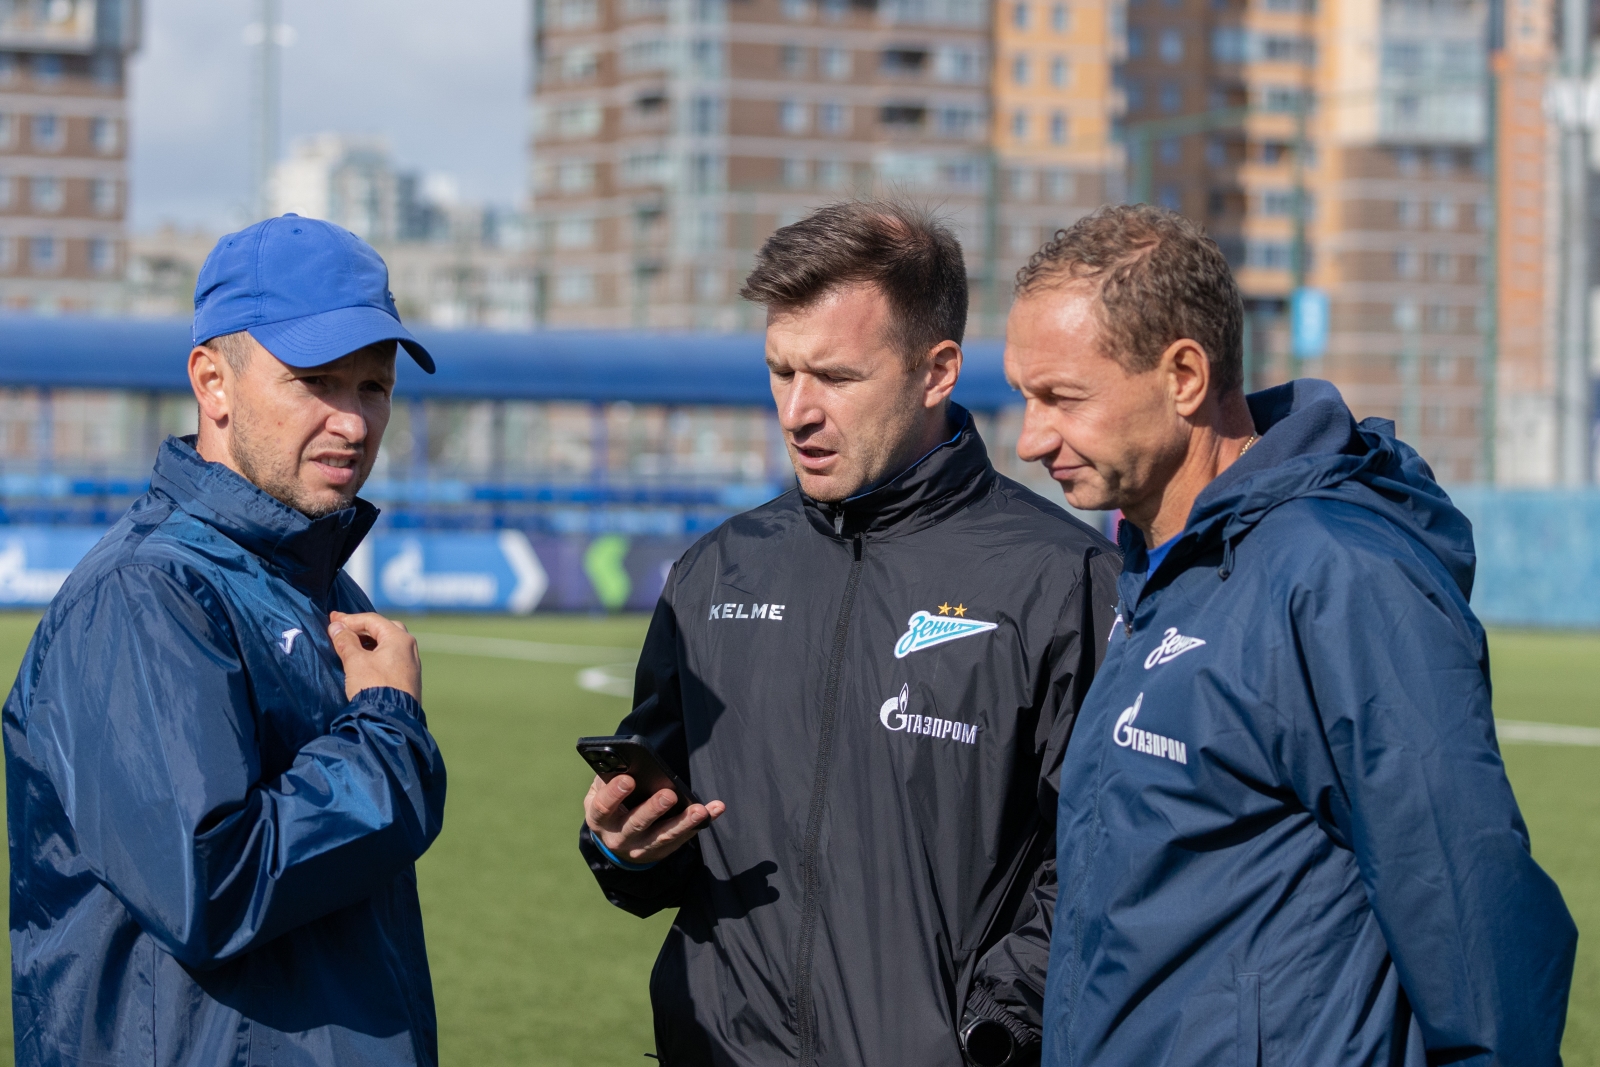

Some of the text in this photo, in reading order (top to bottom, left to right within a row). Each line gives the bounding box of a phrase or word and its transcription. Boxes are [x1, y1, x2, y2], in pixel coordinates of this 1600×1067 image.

[708, 602, 786, 621] KELME
[907, 714, 978, 745] ГАЗПРОМ
[1131, 726, 1188, 765] ГАЗПРОМ
